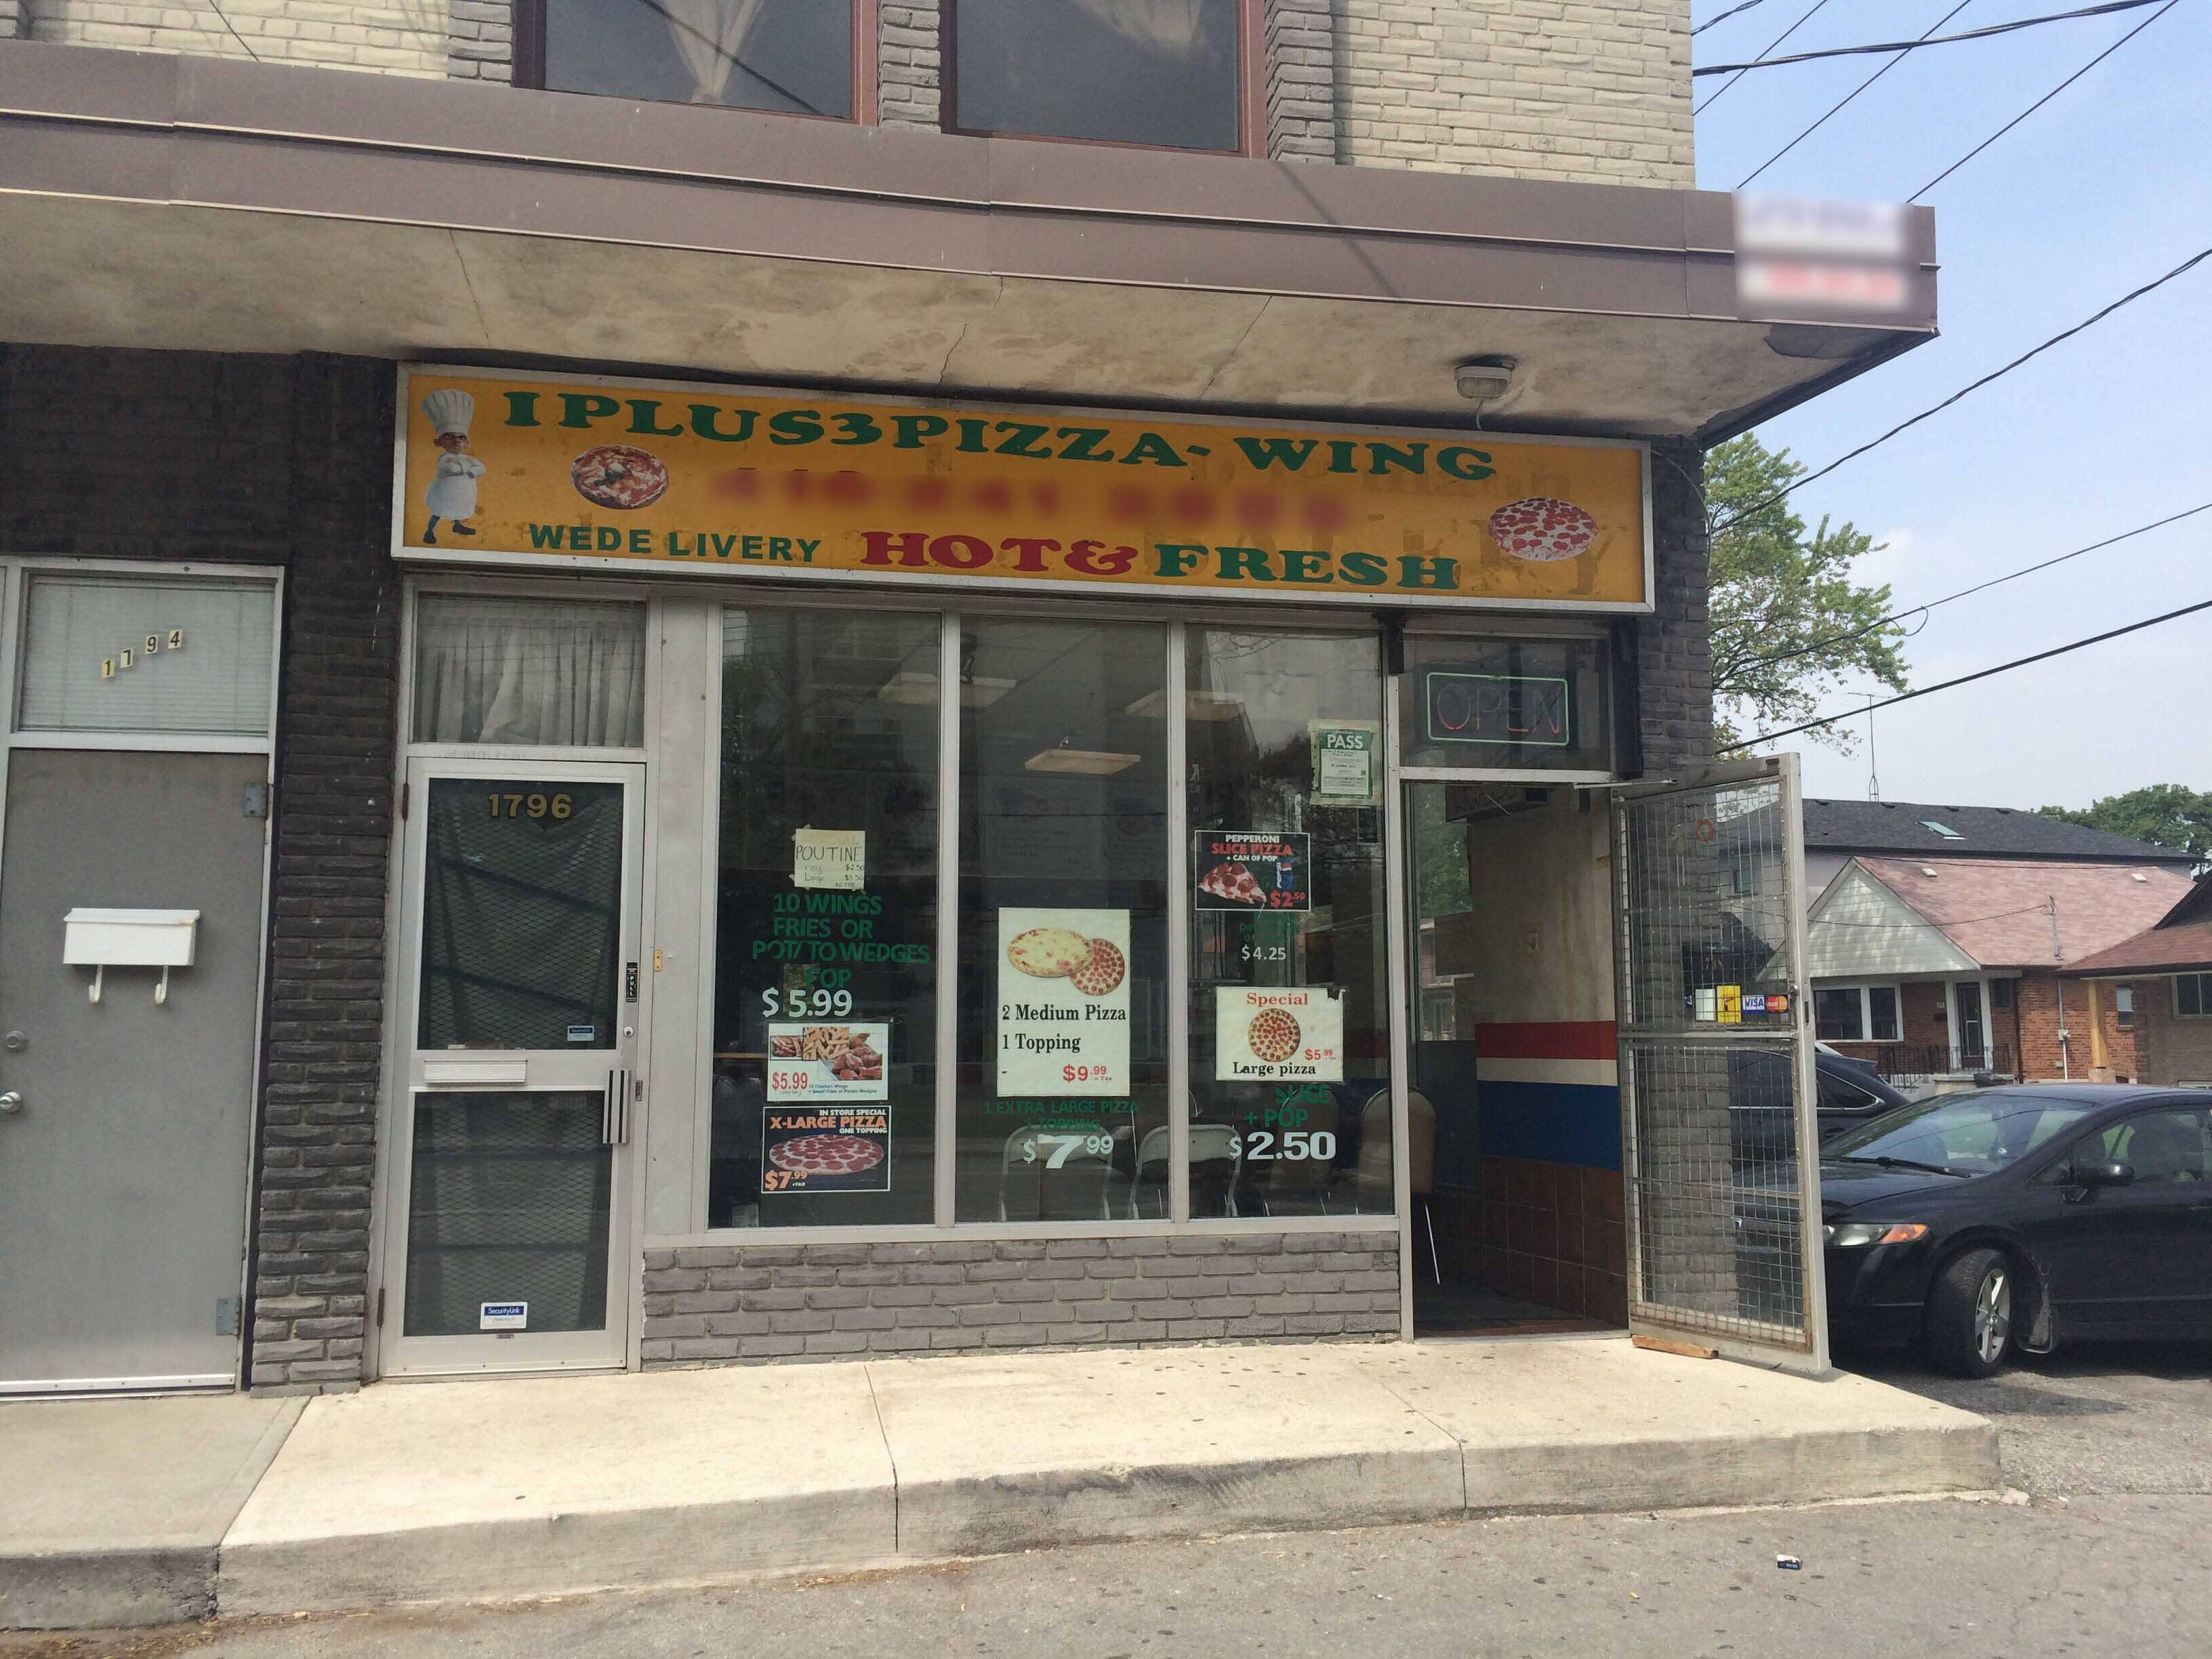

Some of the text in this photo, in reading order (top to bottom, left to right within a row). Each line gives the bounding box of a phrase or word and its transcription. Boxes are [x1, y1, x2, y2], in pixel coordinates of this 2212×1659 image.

[1234, 437, 1496, 480] WING
[670, 531, 821, 562] LIVERY
[1154, 544, 1459, 590] FRESH
[104, 631, 180, 676] 1794
[1327, 734, 1364, 750] PASS
[489, 793, 572, 819] 1796
[1211, 842, 1294, 855] SLICE PIZZA
[1225, 834, 1280, 844] PEPPERONI
[796, 845, 864, 862] POUTINE
[773, 893, 882, 915] 10 WINGS
[773, 917, 873, 939] FRIES OR
[838, 942, 931, 964] WEDGES
[1241, 944, 1286, 962] $4.25
[762, 987, 853, 1017] $5.99
[1246, 992, 1309, 1008] Special
[1745, 998, 1763, 1007] VISA
[1002, 1004, 1127, 1021] 2 Medium Pizza
[1002, 1033, 1082, 1053] 1 Topping
[1233, 1061, 1316, 1078] Large pizza
[772, 1071, 808, 1091] $5.99
[1274, 1084, 1331, 1105] SLICE
[996, 1101, 1045, 1114] EXTRA
[1052, 1101, 1096, 1113] LARGE
[1101, 1101, 1139, 1115] PIZZA
[1263, 1107, 1310, 1128] POP
[769, 1116, 887, 1130] X-LARGE PIZZA
[1229, 1130, 1336, 1161] $2.50
